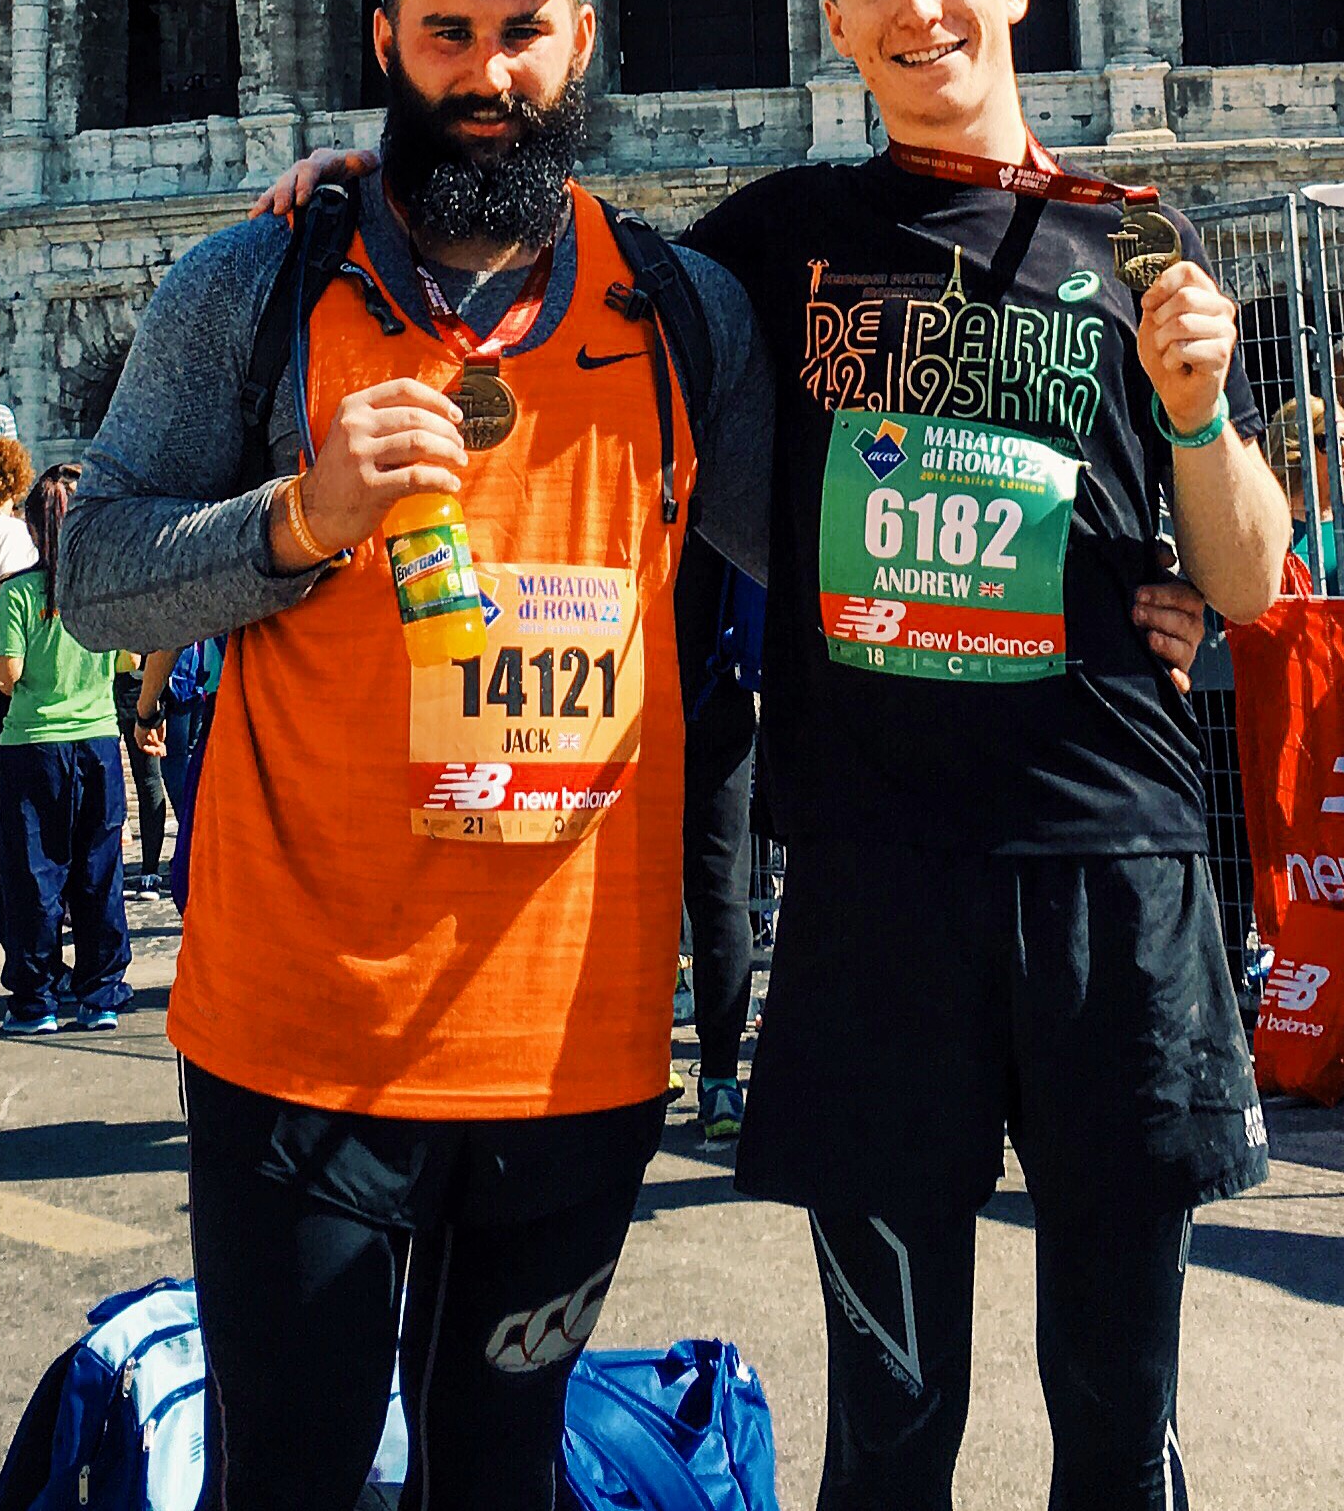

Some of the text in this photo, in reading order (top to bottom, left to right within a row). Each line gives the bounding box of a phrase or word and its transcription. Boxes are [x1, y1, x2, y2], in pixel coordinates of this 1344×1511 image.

[805, 300, 1104, 372] DE PARIS
[867, 448, 901, 463] acea
[923, 425, 1040, 462] MARATON
[921, 449, 942, 469] di
[864, 488, 1023, 570] 6182
[518, 575, 620, 600] MARATONA
[873, 566, 972, 598] ANDREW
[518, 599, 537, 620] di
[544, 599, 597, 622] ROMA
[833, 596, 1054, 657] NB new balance
[866, 647, 963, 674] 18 C
[451, 647, 615, 718] 14121
[502, 727, 552, 754] JACK
[423, 763, 512, 810] NB
[513, 789, 556, 811] new
[463, 816, 484, 834] 21
[1267, 1013, 1324, 1037] balance
